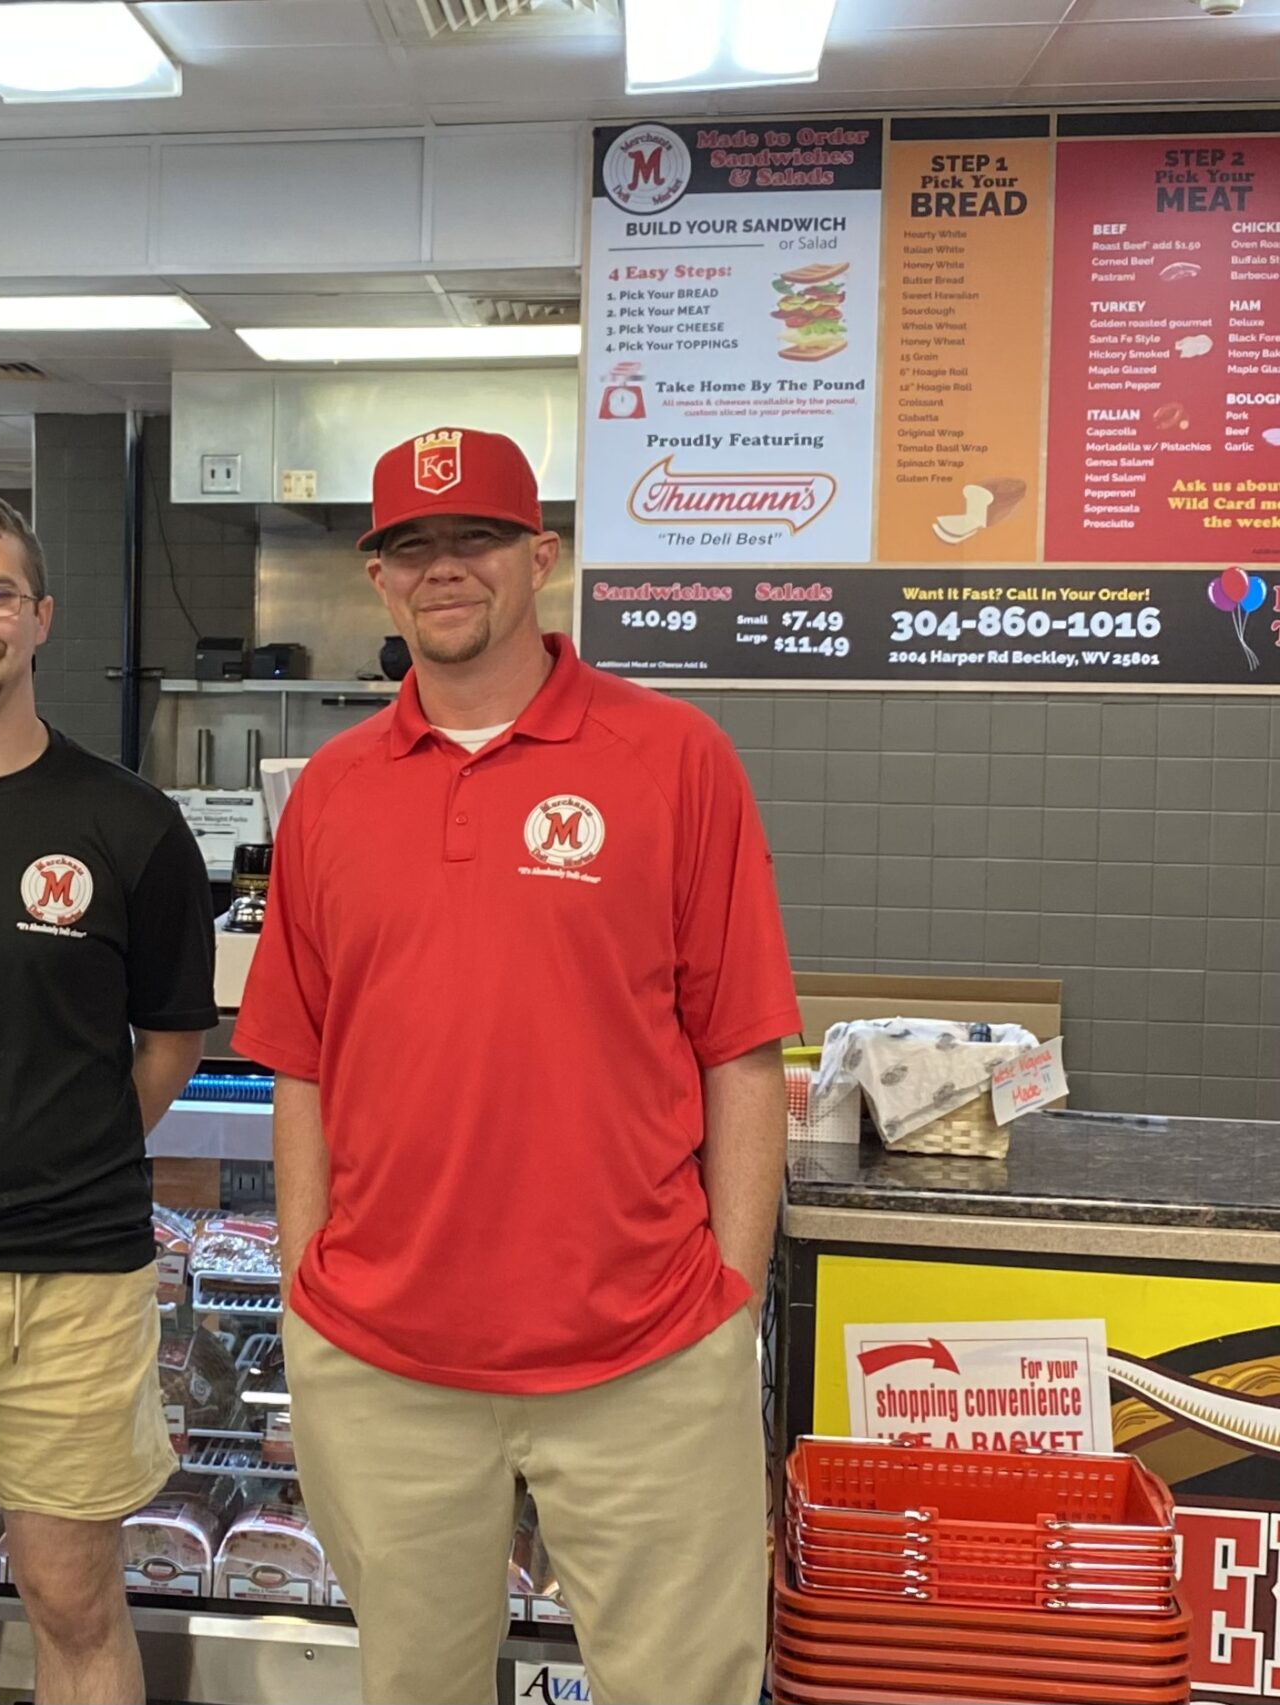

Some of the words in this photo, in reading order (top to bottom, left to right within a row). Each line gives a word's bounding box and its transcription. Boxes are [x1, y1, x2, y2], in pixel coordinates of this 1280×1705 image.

[696, 129, 759, 149] Made
[765, 128, 790, 146] to
[796, 127, 869, 145] Order
[710, 147, 854, 168] Sandwiches
[931, 155, 990, 172] STEP
[995, 157, 1008, 171] 1
[1165, 149, 1225, 167] STEP
[1231, 152, 1245, 166] 2
[627, 147, 666, 191] M
[729, 169, 751, 187] &
[756, 167, 834, 186] Salads
[921, 176, 964, 188] Pick
[971, 175, 1018, 188] Your
[1155, 170, 1198, 184] Pick
[1207, 169, 1255, 183] Your
[911, 191, 1027, 218] BREAD
[1156, 185, 1253, 213] MEAT
[626, 221, 681, 236] BUILD
[686, 219, 737, 235] YOUR
[742, 217, 846, 233] SANDWICH
[1093, 224, 1127, 235] BEEF
[779, 239, 794, 250] or
[798, 235, 837, 250] Salad
[1092, 242, 1120, 250] Roast
[1152, 241, 1172, 250] add
[1231, 240, 1258, 249] Oven
[1092, 257, 1128, 266] Corned
[1131, 256, 1155, 266] Beef
[1231, 255, 1267, 264] Buffalo
[608, 268, 619, 281] 4
[626, 266, 668, 282] Easy
[674, 264, 732, 281] Steps:
[1091, 272, 1136, 282] Pastrami
[1231, 271, 1279, 280] Barbecue
[620, 290, 645, 300] Pick
[647, 290, 675, 300] Your
[677, 288, 719, 299] BREAD
[620, 307, 645, 317] Pick
[647, 306, 675, 316] Your
[677, 305, 711, 316] MEAT
[1090, 301, 1146, 312] TURKEY
[1230, 300, 1260, 311] HAM
[619, 324, 644, 334] Pick
[646, 324, 674, 334] Your
[676, 322, 725, 333] CHEESE
[1090, 319, 1126, 328] Golden
[1128, 319, 1167, 328] roasted
[1169, 319, 1212, 330] gourmet
[1229, 318, 1264, 327] Deluxe
[1089, 335, 1118, 343] Santa
[1120, 335, 1134, 343] Fe
[1135, 335, 1160, 345] Style
[1228, 333, 1256, 342] Black
[619, 341, 644, 351] Pick
[646, 341, 674, 351] Your
[676, 339, 739, 350] TOPPINGS
[1089, 350, 1127, 360] Hickory
[1129, 350, 1170, 359] Smoked
[1228, 349, 1260, 360] Honey
[1088, 366, 1120, 375] Maple
[1122, 365, 1157, 374] Glazed
[1227, 365, 1259, 375] Maple
[656, 381, 696, 393] Take
[700, 381, 746, 392] Home
[751, 380, 772, 394] By
[776, 380, 807, 392] The
[812, 379, 866, 391] Pound
[1088, 381, 1122, 390] Lemon
[1124, 381, 1161, 391] Pepper
[1087, 409, 1140, 420] ITALIAN
[1226, 411, 1249, 420] Pork
[1225, 427, 1249, 436] Beef
[646, 434, 723, 449] Proudly
[729, 433, 824, 449] Featuring
[1086, 443, 1142, 451] Mortadella
[1161, 443, 1212, 452] Pistachios
[1225, 443, 1254, 452] Garlic
[421, 454, 454, 481] KC
[1085, 458, 1117, 467] Genoa
[1120, 458, 1154, 467] Salami
[1085, 473, 1109, 482] Hard
[1111, 473, 1146, 482] Salami
[1172, 479, 1207, 492] Ask
[1212, 481, 1231, 492] us
[643, 479, 815, 512] Thumann's
[1084, 489, 1136, 499] Pepperoni
[1084, 504, 1140, 514] Sopressata
[1168, 497, 1209, 510] Wild
[1213, 498, 1256, 510] Card
[1083, 520, 1135, 528] Prosciutto
[1203, 516, 1232, 528] the
[658, 532, 695, 546] "The
[700, 532, 731, 545] Deli
[736, 532, 782, 545] Best"
[593, 583, 732, 601] Sandwiches
[755, 582, 832, 601] Salads
[903, 588, 944, 601] Want
[947, 587, 959, 600] It
[963, 587, 1002, 601] Fast?
[1006, 588, 1038, 601] Call
[1041, 588, 1057, 601] In
[1059, 588, 1096, 601] Your
[1099, 587, 1150, 601] Order!
[621, 610, 697, 631] $10.99
[736, 614, 768, 625] Small
[782, 611, 843, 631] $7.49
[890, 607, 1161, 642] 304-860-1016
[736, 632, 768, 645] Large
[774, 636, 849, 657] $11.49
[889, 652, 927, 665] 2004
[931, 651, 984, 666] Harper
[988, 651, 1009, 664] Rd
[1012, 651, 1079, 667] Beckley,
[1082, 651, 1109, 664] WV
[1112, 653, 1160, 666] 25801
[541, 811, 583, 850] M
[38, 870, 75, 907] M
[1021, 1357, 1042, 1380] For
[1047, 1360, 1078, 1383] your
[876, 1383, 958, 1423] shopping
[964, 1382, 1082, 1417] convenience
